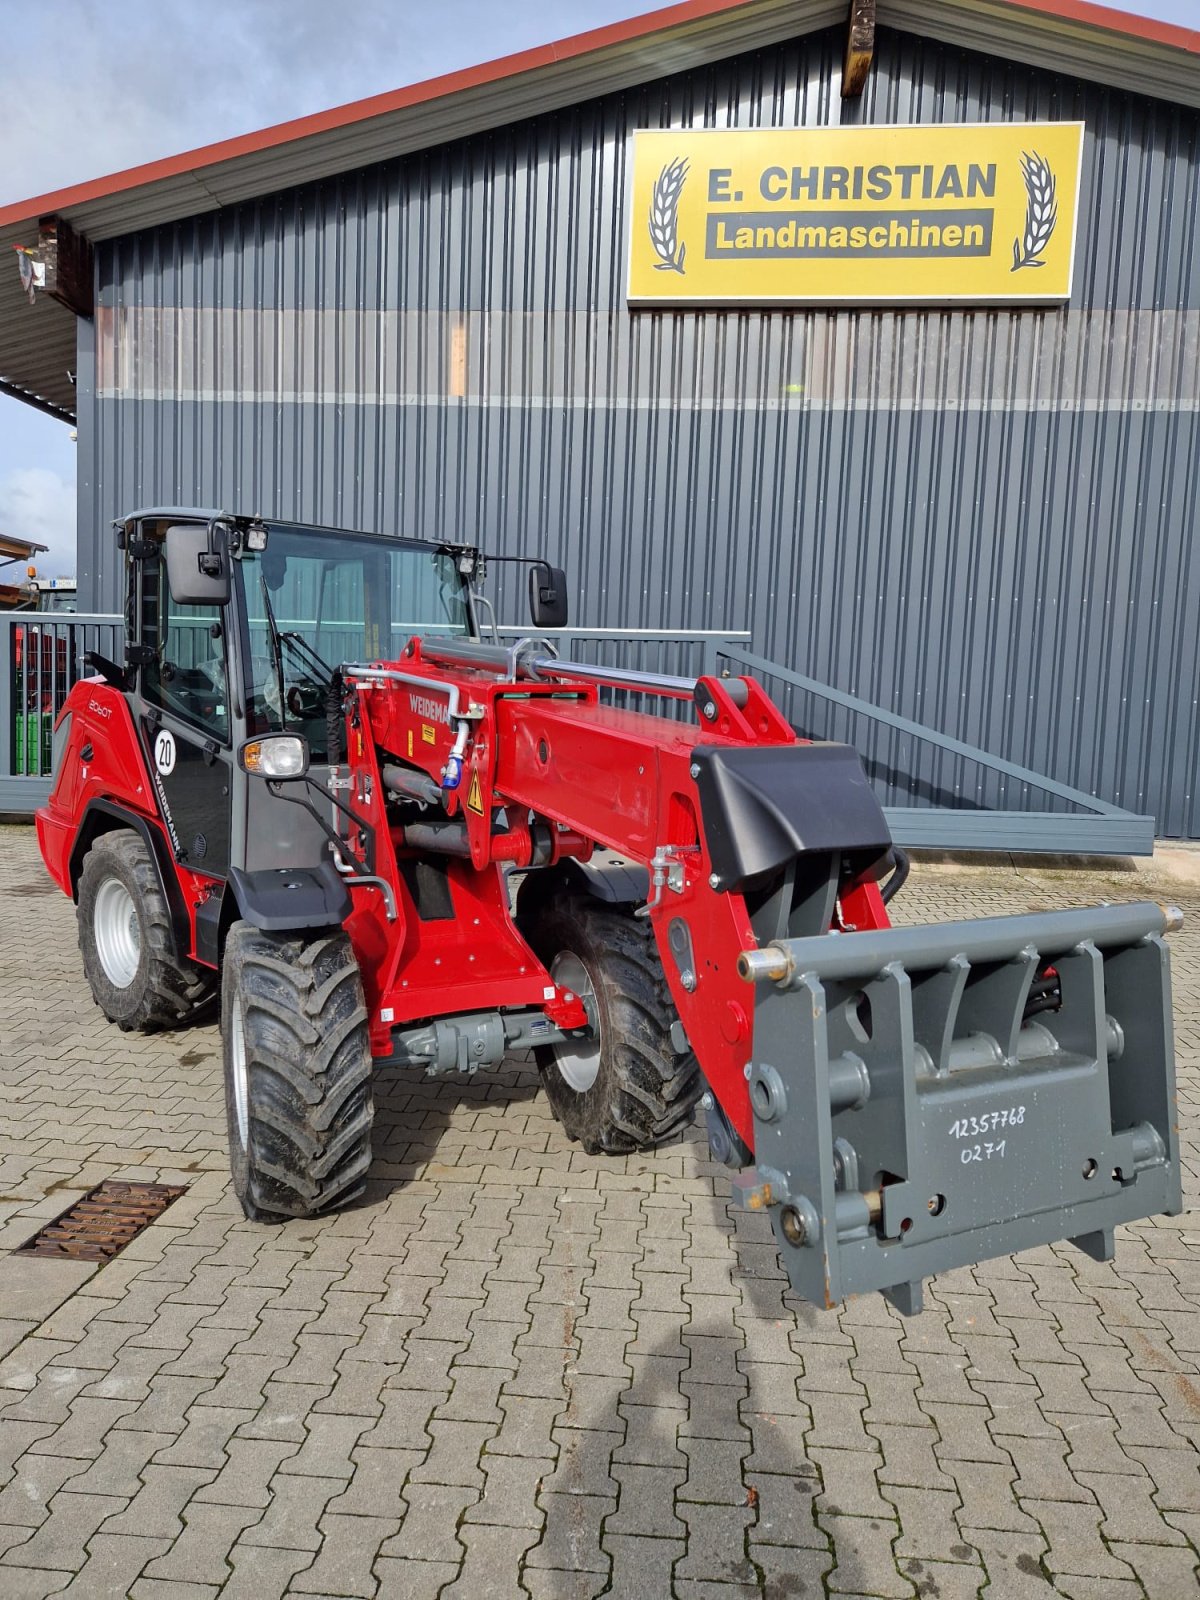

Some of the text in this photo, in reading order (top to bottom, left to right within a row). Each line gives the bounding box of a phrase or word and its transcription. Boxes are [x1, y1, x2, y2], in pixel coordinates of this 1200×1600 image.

[708, 163, 997, 202] E. CHRISTIAN
[716, 218, 984, 249] Landmaschinen
[159, 738, 172, 767] 20
[155, 770, 181, 852] WEIDEMANN
[948, 1106, 1026, 1139] 12357768
[961, 1140, 1006, 1164] 0271
